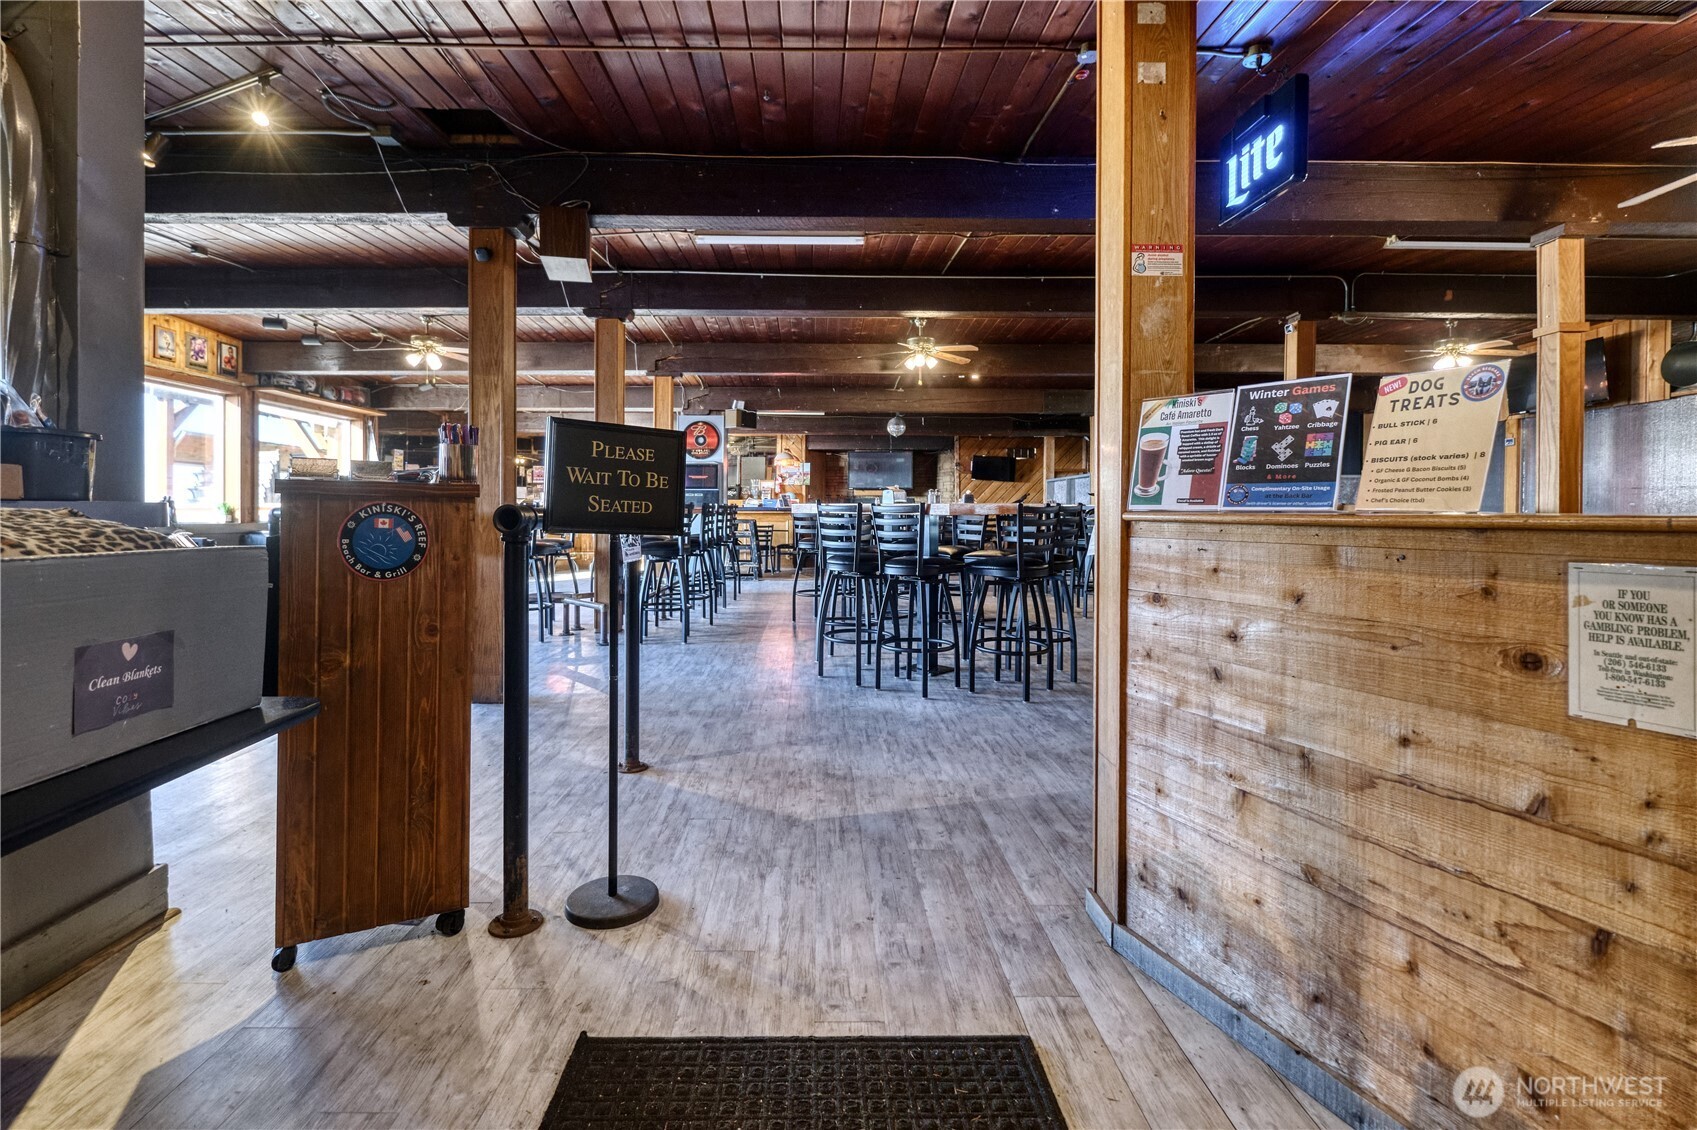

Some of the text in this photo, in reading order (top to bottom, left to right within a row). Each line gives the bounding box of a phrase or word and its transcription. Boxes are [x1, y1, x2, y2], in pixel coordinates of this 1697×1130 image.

[1226, 124, 1283, 208] Lite
[1250, 384, 1336, 400] Winter Games
[1384, 381, 1402, 394] NEW!
[1408, 377, 1445, 394] DOG
[1172, 398, 1202, 409] Kiniski's
[1390, 392, 1460, 412] TREATS
[1160, 411, 1175, 421] Café
[1178, 409, 1212, 419] Amaretto
[1307, 421, 1338, 429] Cribbage
[1400, 419, 1426, 428] STICK
[592, 441, 655, 462] PLEASE
[1440, 452, 1469, 460] varies)
[566, 466, 669, 489] WAIT TO BE
[588, 495, 653, 514] SEATED
[359, 503, 426, 548] KINISKI'S REEF
[342, 539, 355, 564] Beach
[355, 564, 371, 575] Bar
[385, 566, 407, 578] Grill
[1618, 589, 1650, 600] IF YOU
[1602, 600, 1668, 614] OR SOMEONE
[1594, 610, 1678, 627] YOU KNOW HAS A
[1584, 621, 1690, 640] GAMBLING PROBLEM,
[1589, 632, 1685, 651] HELP IS AVAILABLE.
[1601, 650, 1622, 658] Seattle
[1598, 665, 1622, 674] Toll-free
[1604, 658, 1666, 672] (206) 546-6133
[89, 665, 162, 691] Clean Blankets
[1605, 673, 1666, 688] 1-800-547-6133
